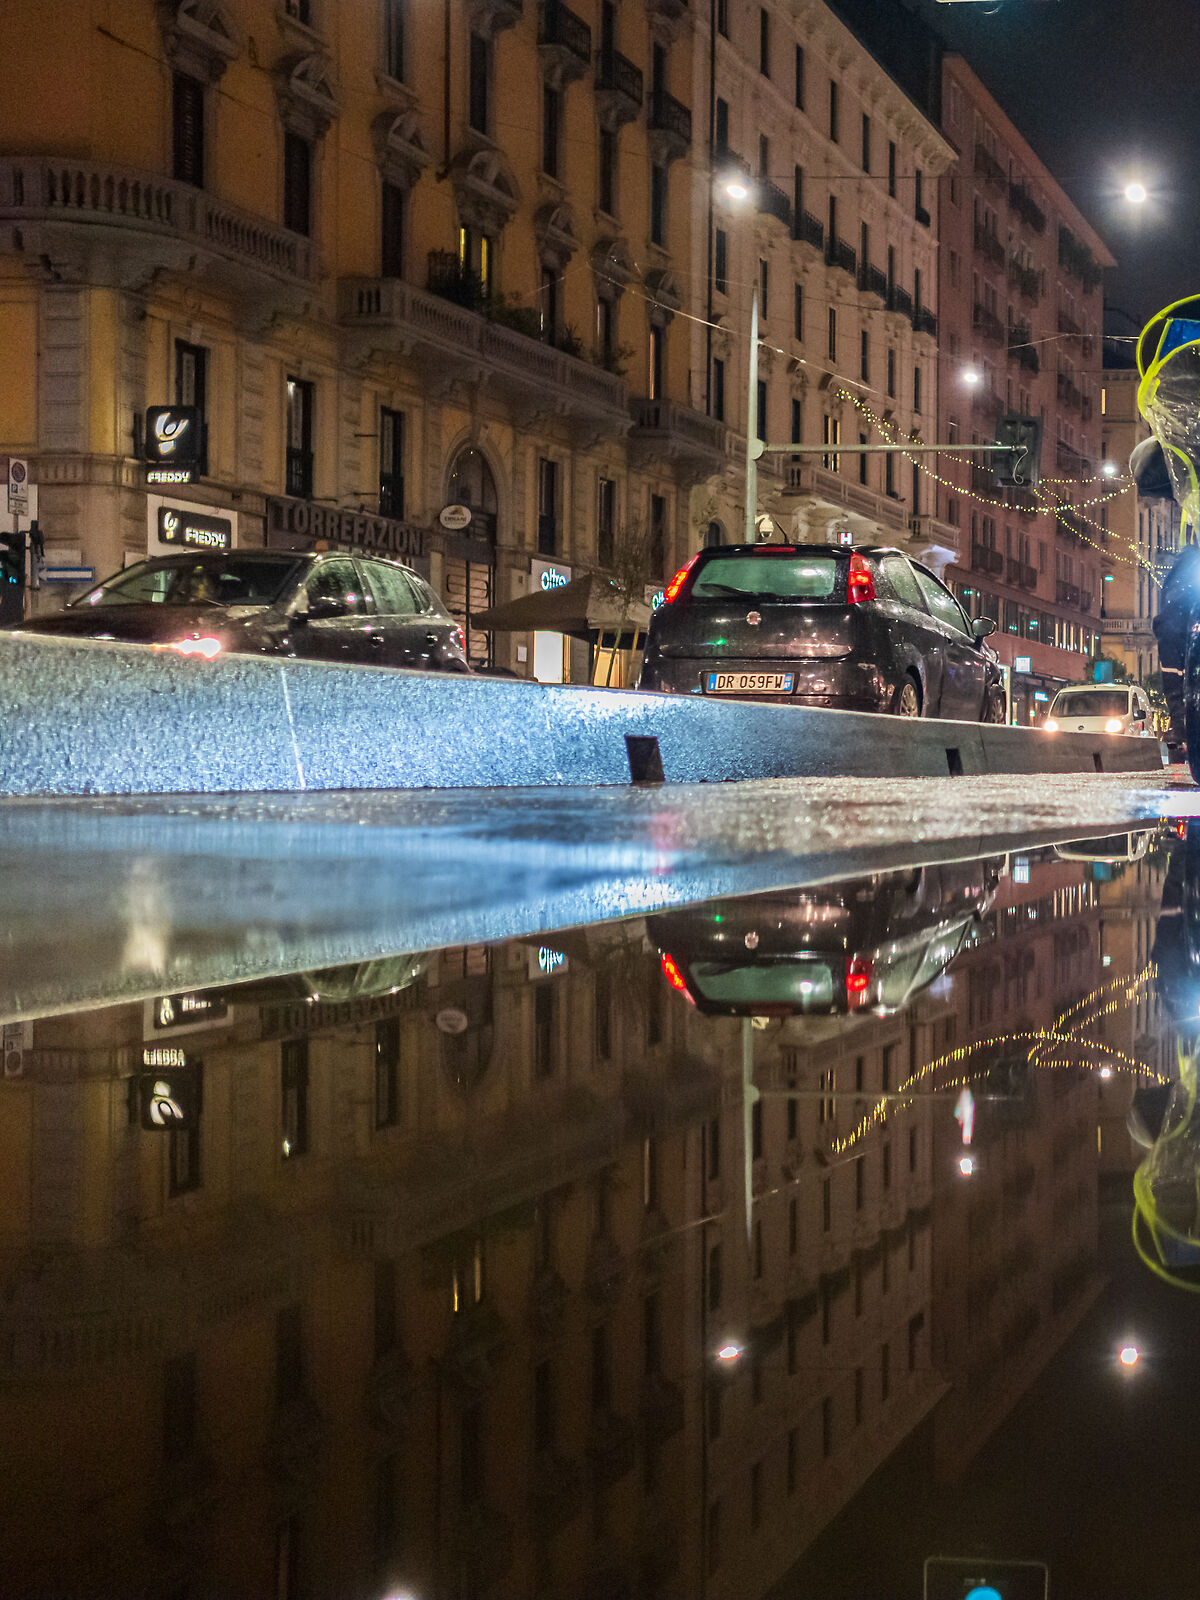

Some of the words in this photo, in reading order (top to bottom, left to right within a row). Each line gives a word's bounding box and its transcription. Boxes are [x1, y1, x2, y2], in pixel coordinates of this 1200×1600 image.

[147, 471, 190, 483] FREDDY
[185, 527, 227, 548] FREDDY
[717, 675, 735, 689] DR
